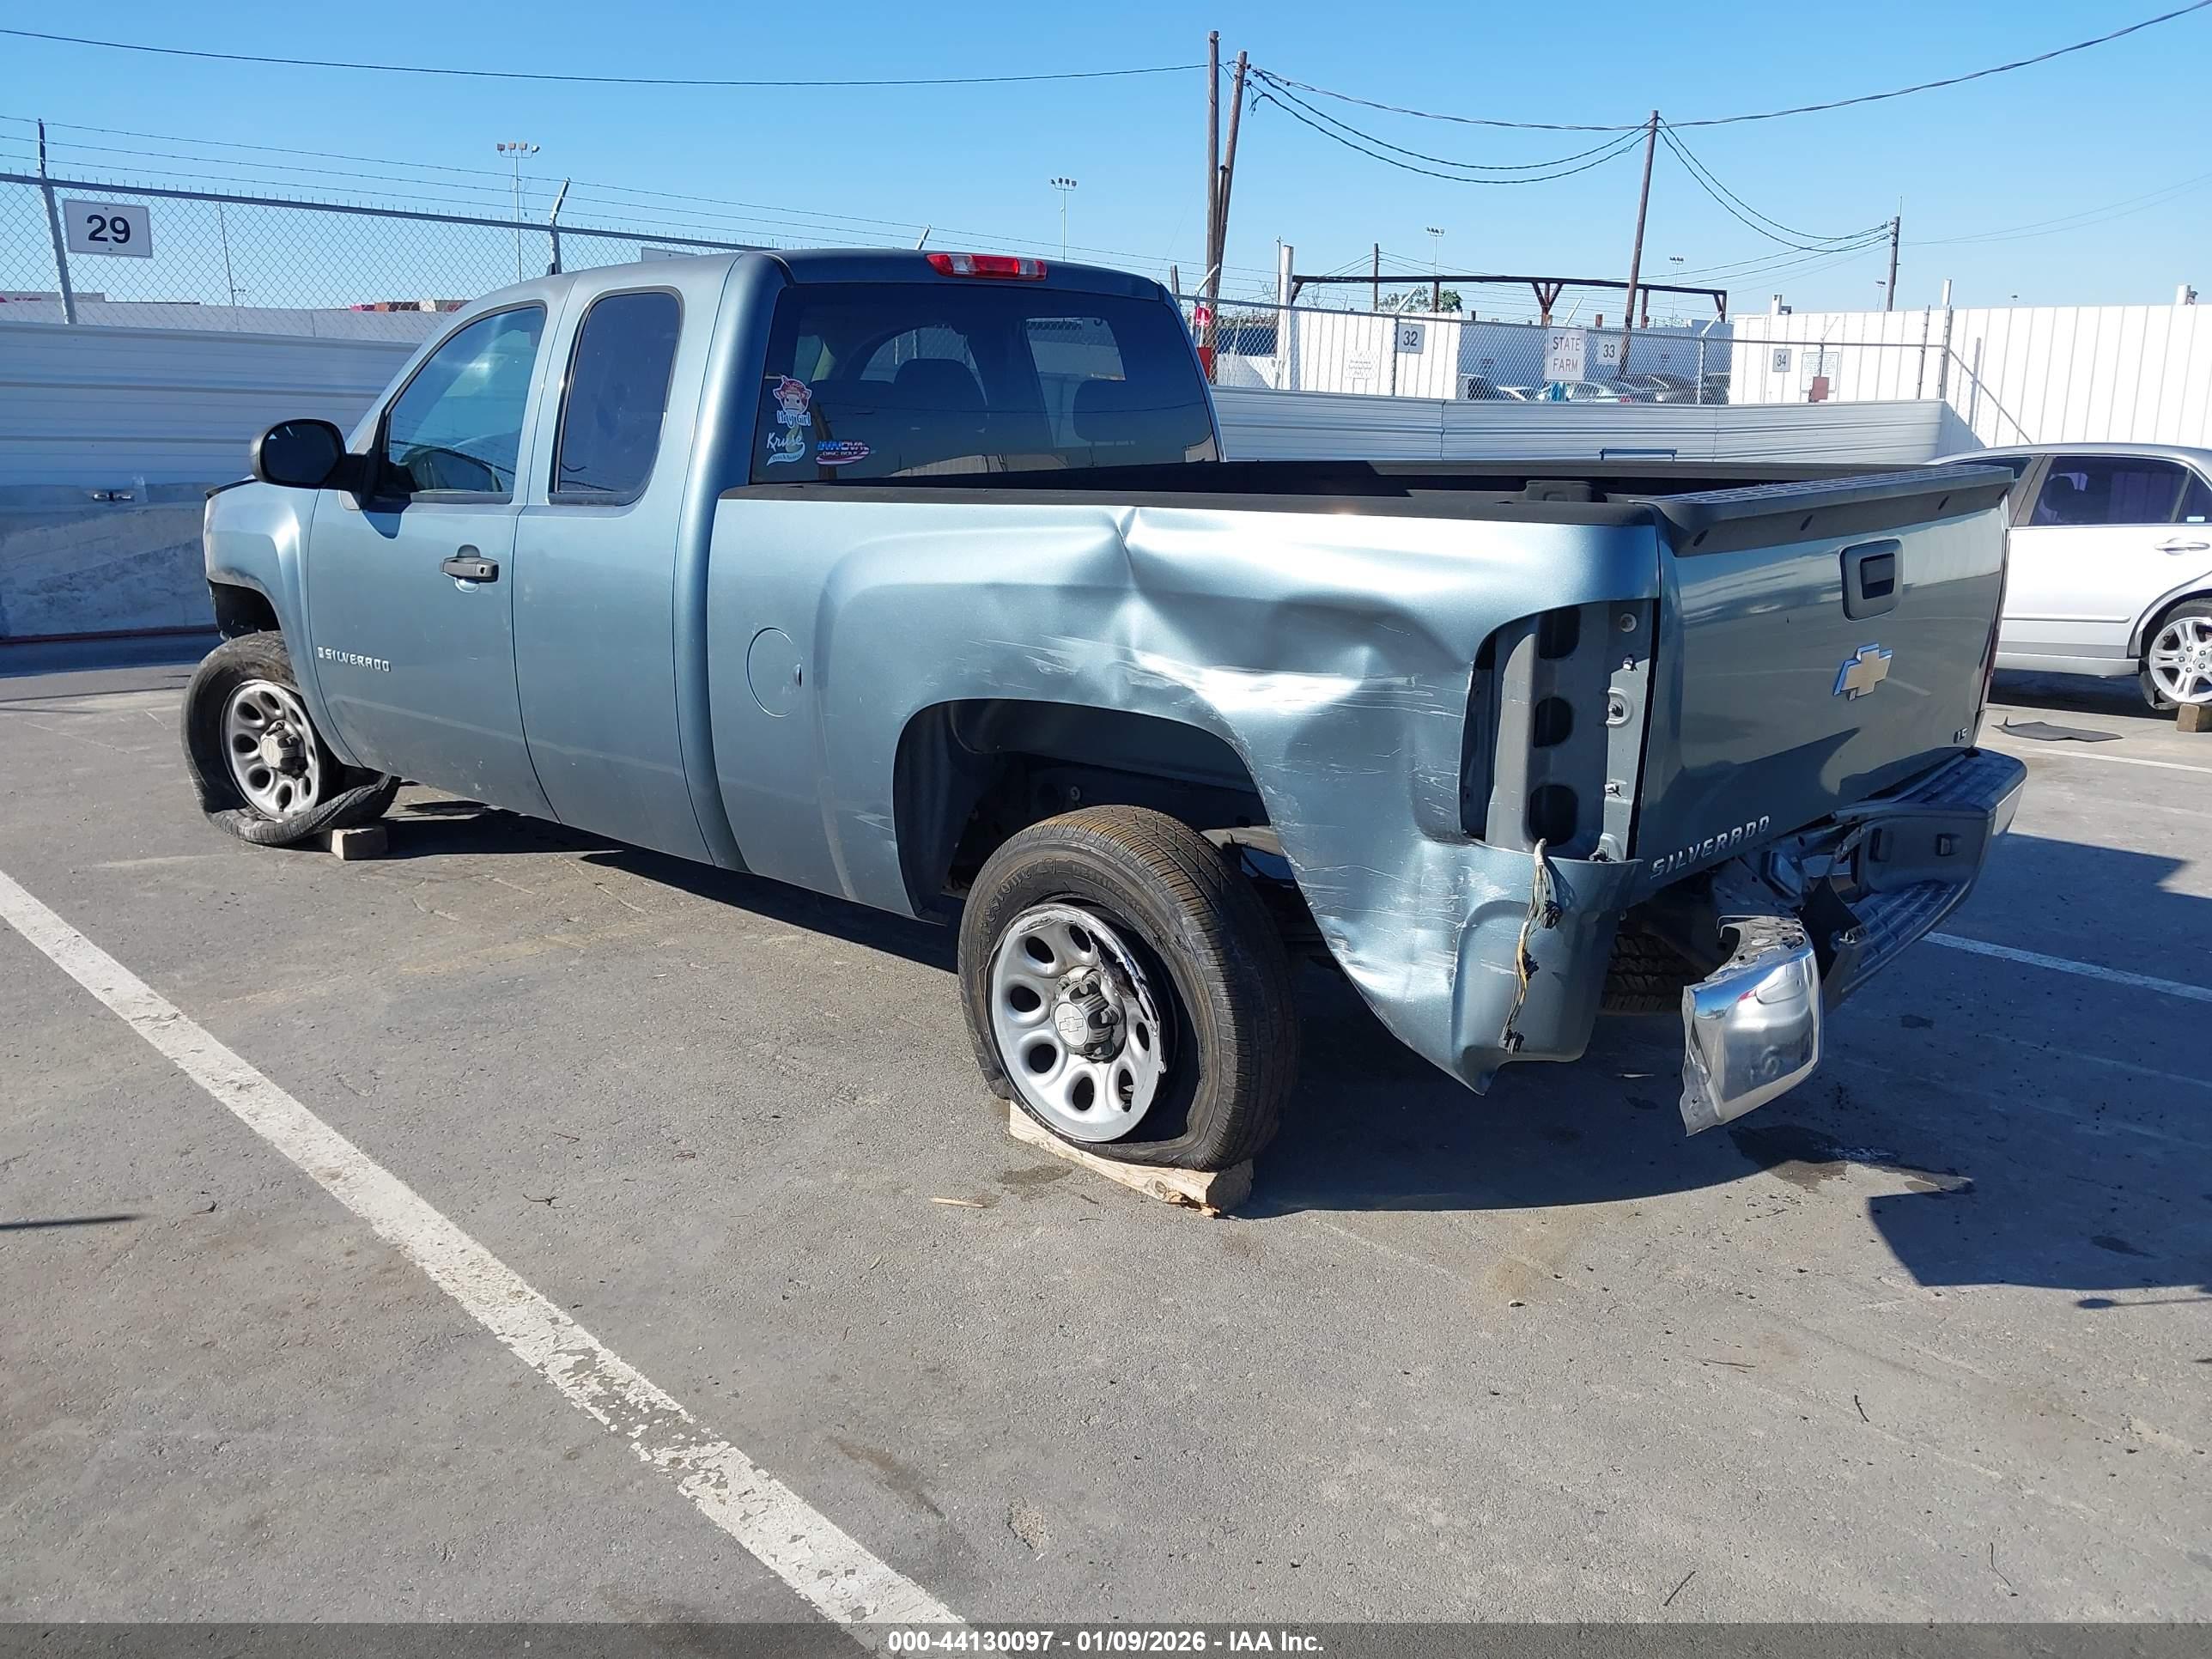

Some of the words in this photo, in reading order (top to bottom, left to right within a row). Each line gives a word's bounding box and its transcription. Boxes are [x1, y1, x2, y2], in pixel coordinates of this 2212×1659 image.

[87, 214, 131, 244] 29
[1403, 331, 1419, 346] 32
[1553, 336, 1581, 352] STATE
[1602, 344, 1616, 359] 33
[1553, 357, 1578, 373] FARM
[1777, 354, 1787, 367] 34
[325, 647, 391, 672] SILVERADO
[1650, 815, 1771, 880] SILVERADO
